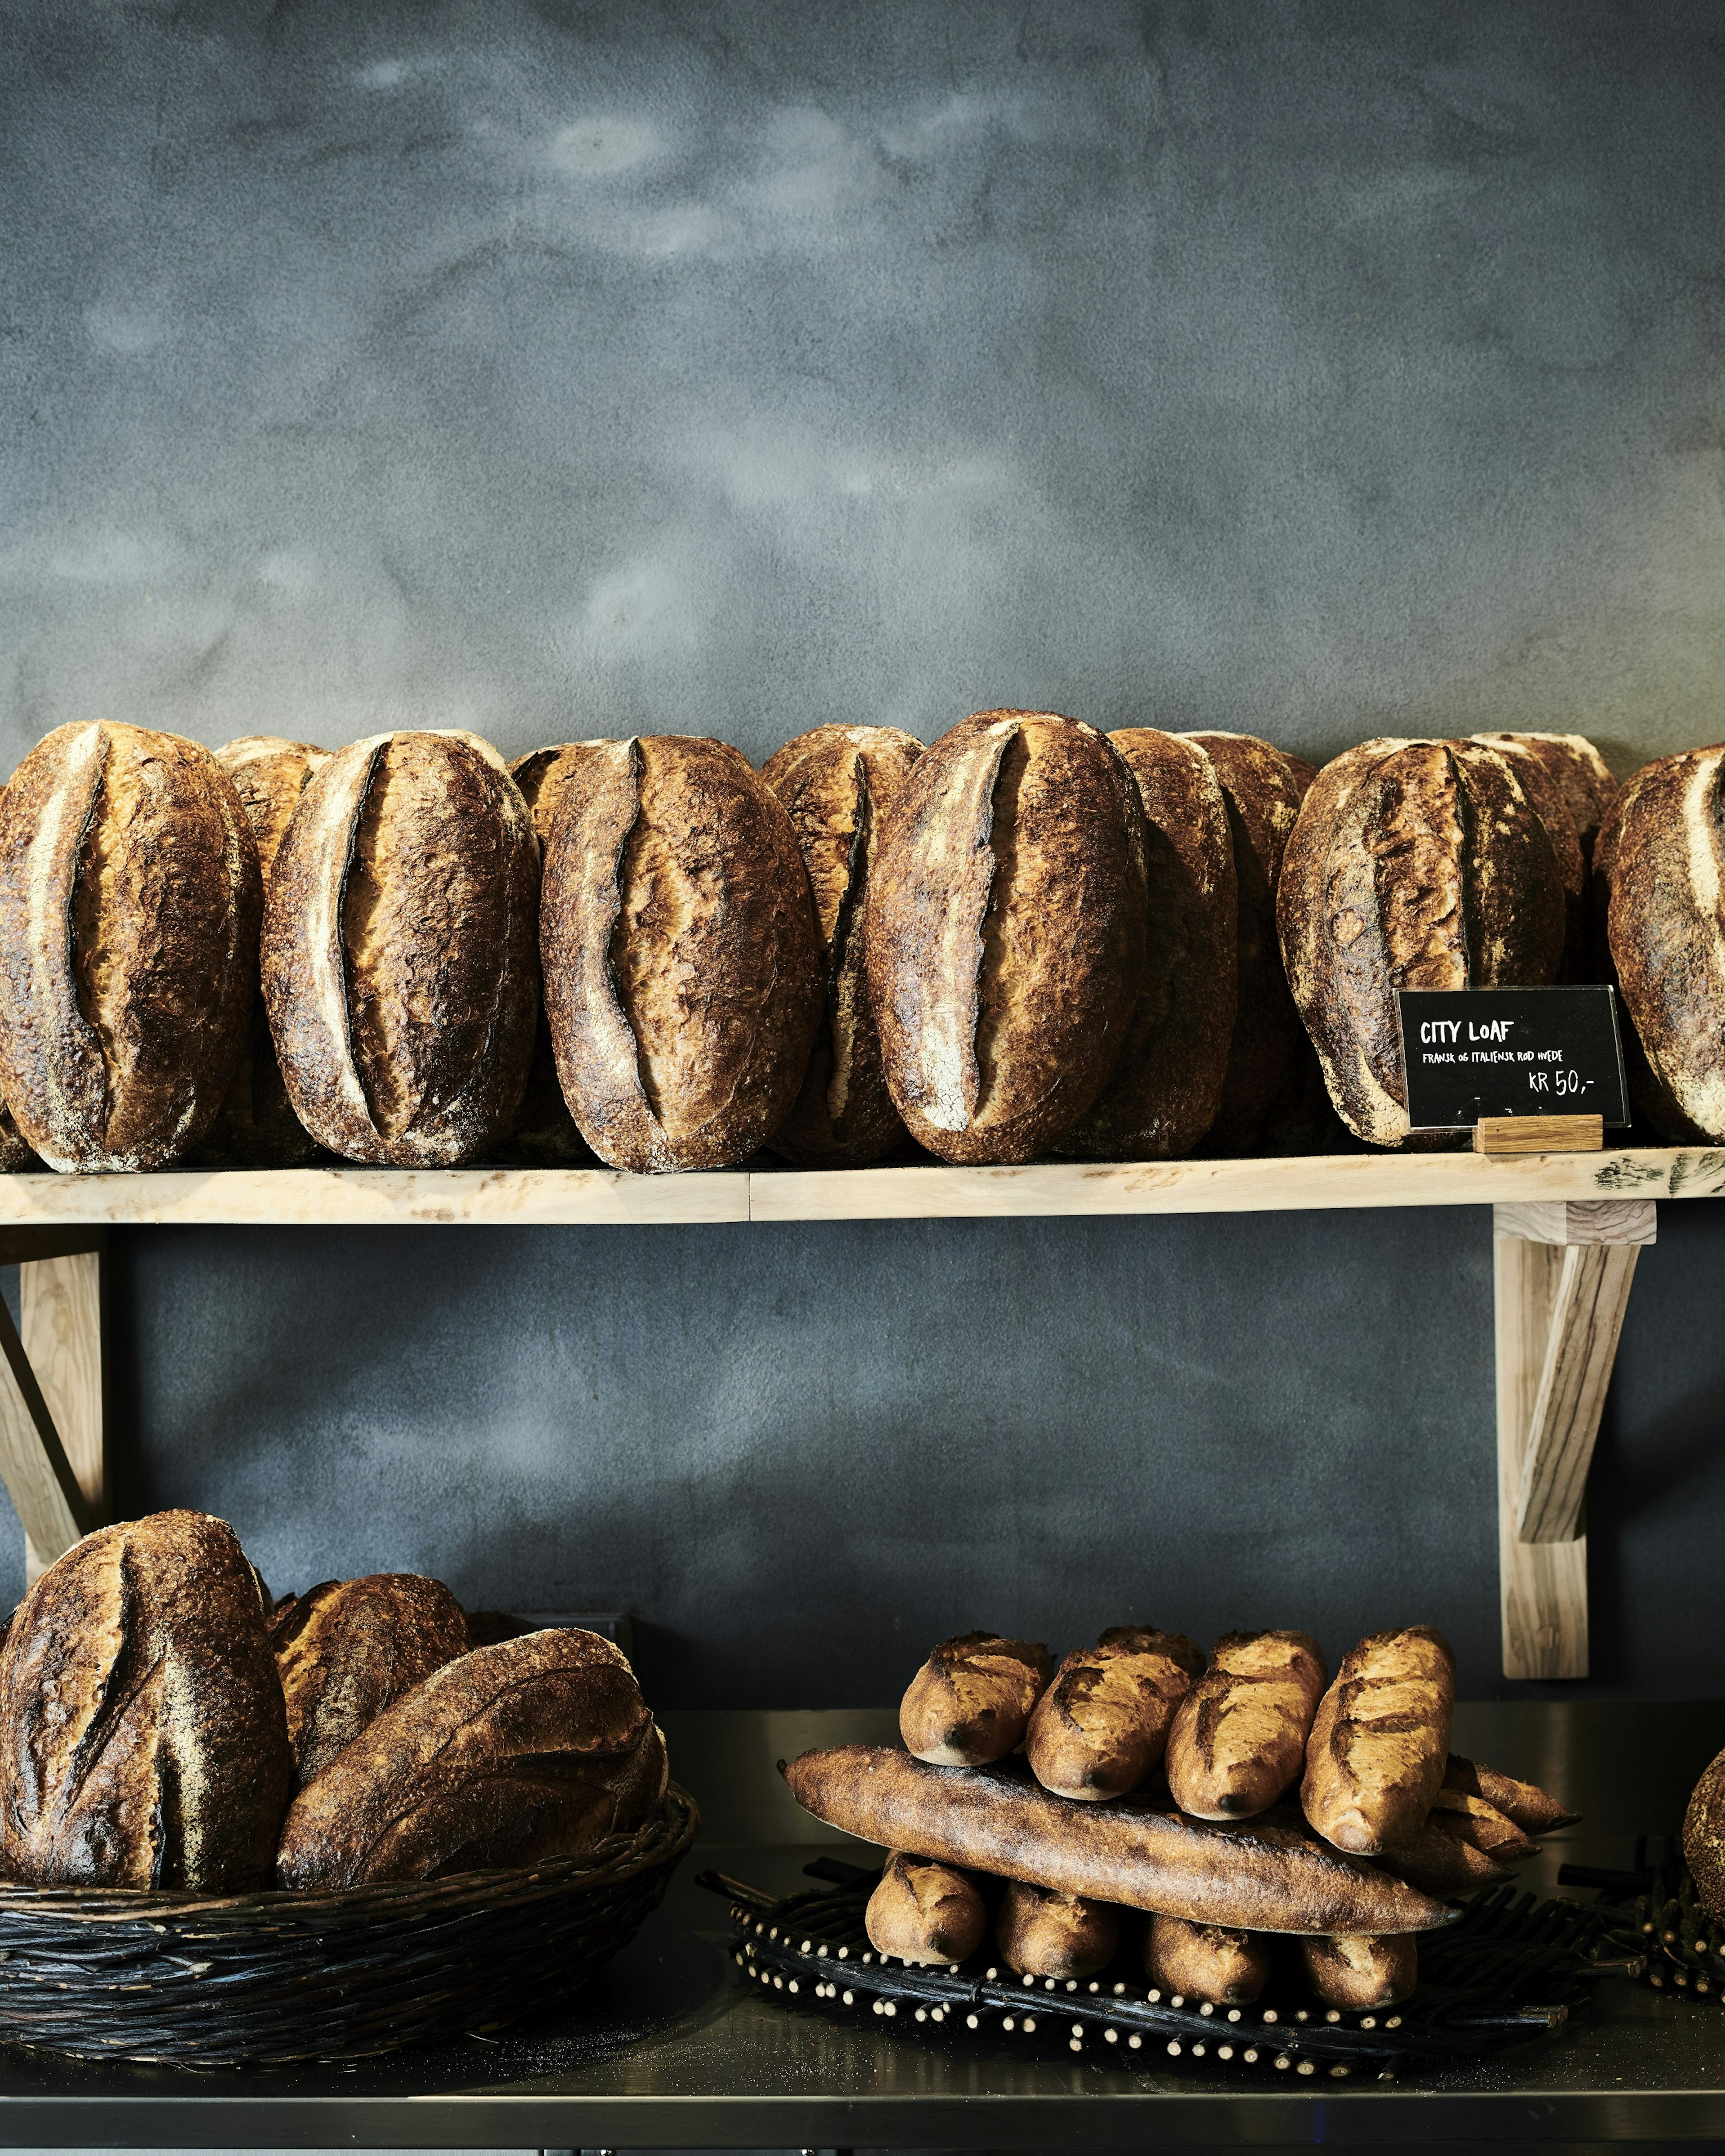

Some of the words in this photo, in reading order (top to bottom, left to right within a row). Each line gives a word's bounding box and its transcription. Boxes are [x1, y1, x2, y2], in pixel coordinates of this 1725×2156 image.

[1420, 1020, 1462, 1044] CITY
[1422, 1052, 1456, 1064] FRANSK
[1471, 1051, 1515, 1063] ITALIENSK
[1517, 1051, 1535, 1062] RØD
[1537, 1049, 1563, 1062] HVEDE
[1528, 1071, 1549, 1093] KR
[1555, 1069, 1595, 1096] 50,-
